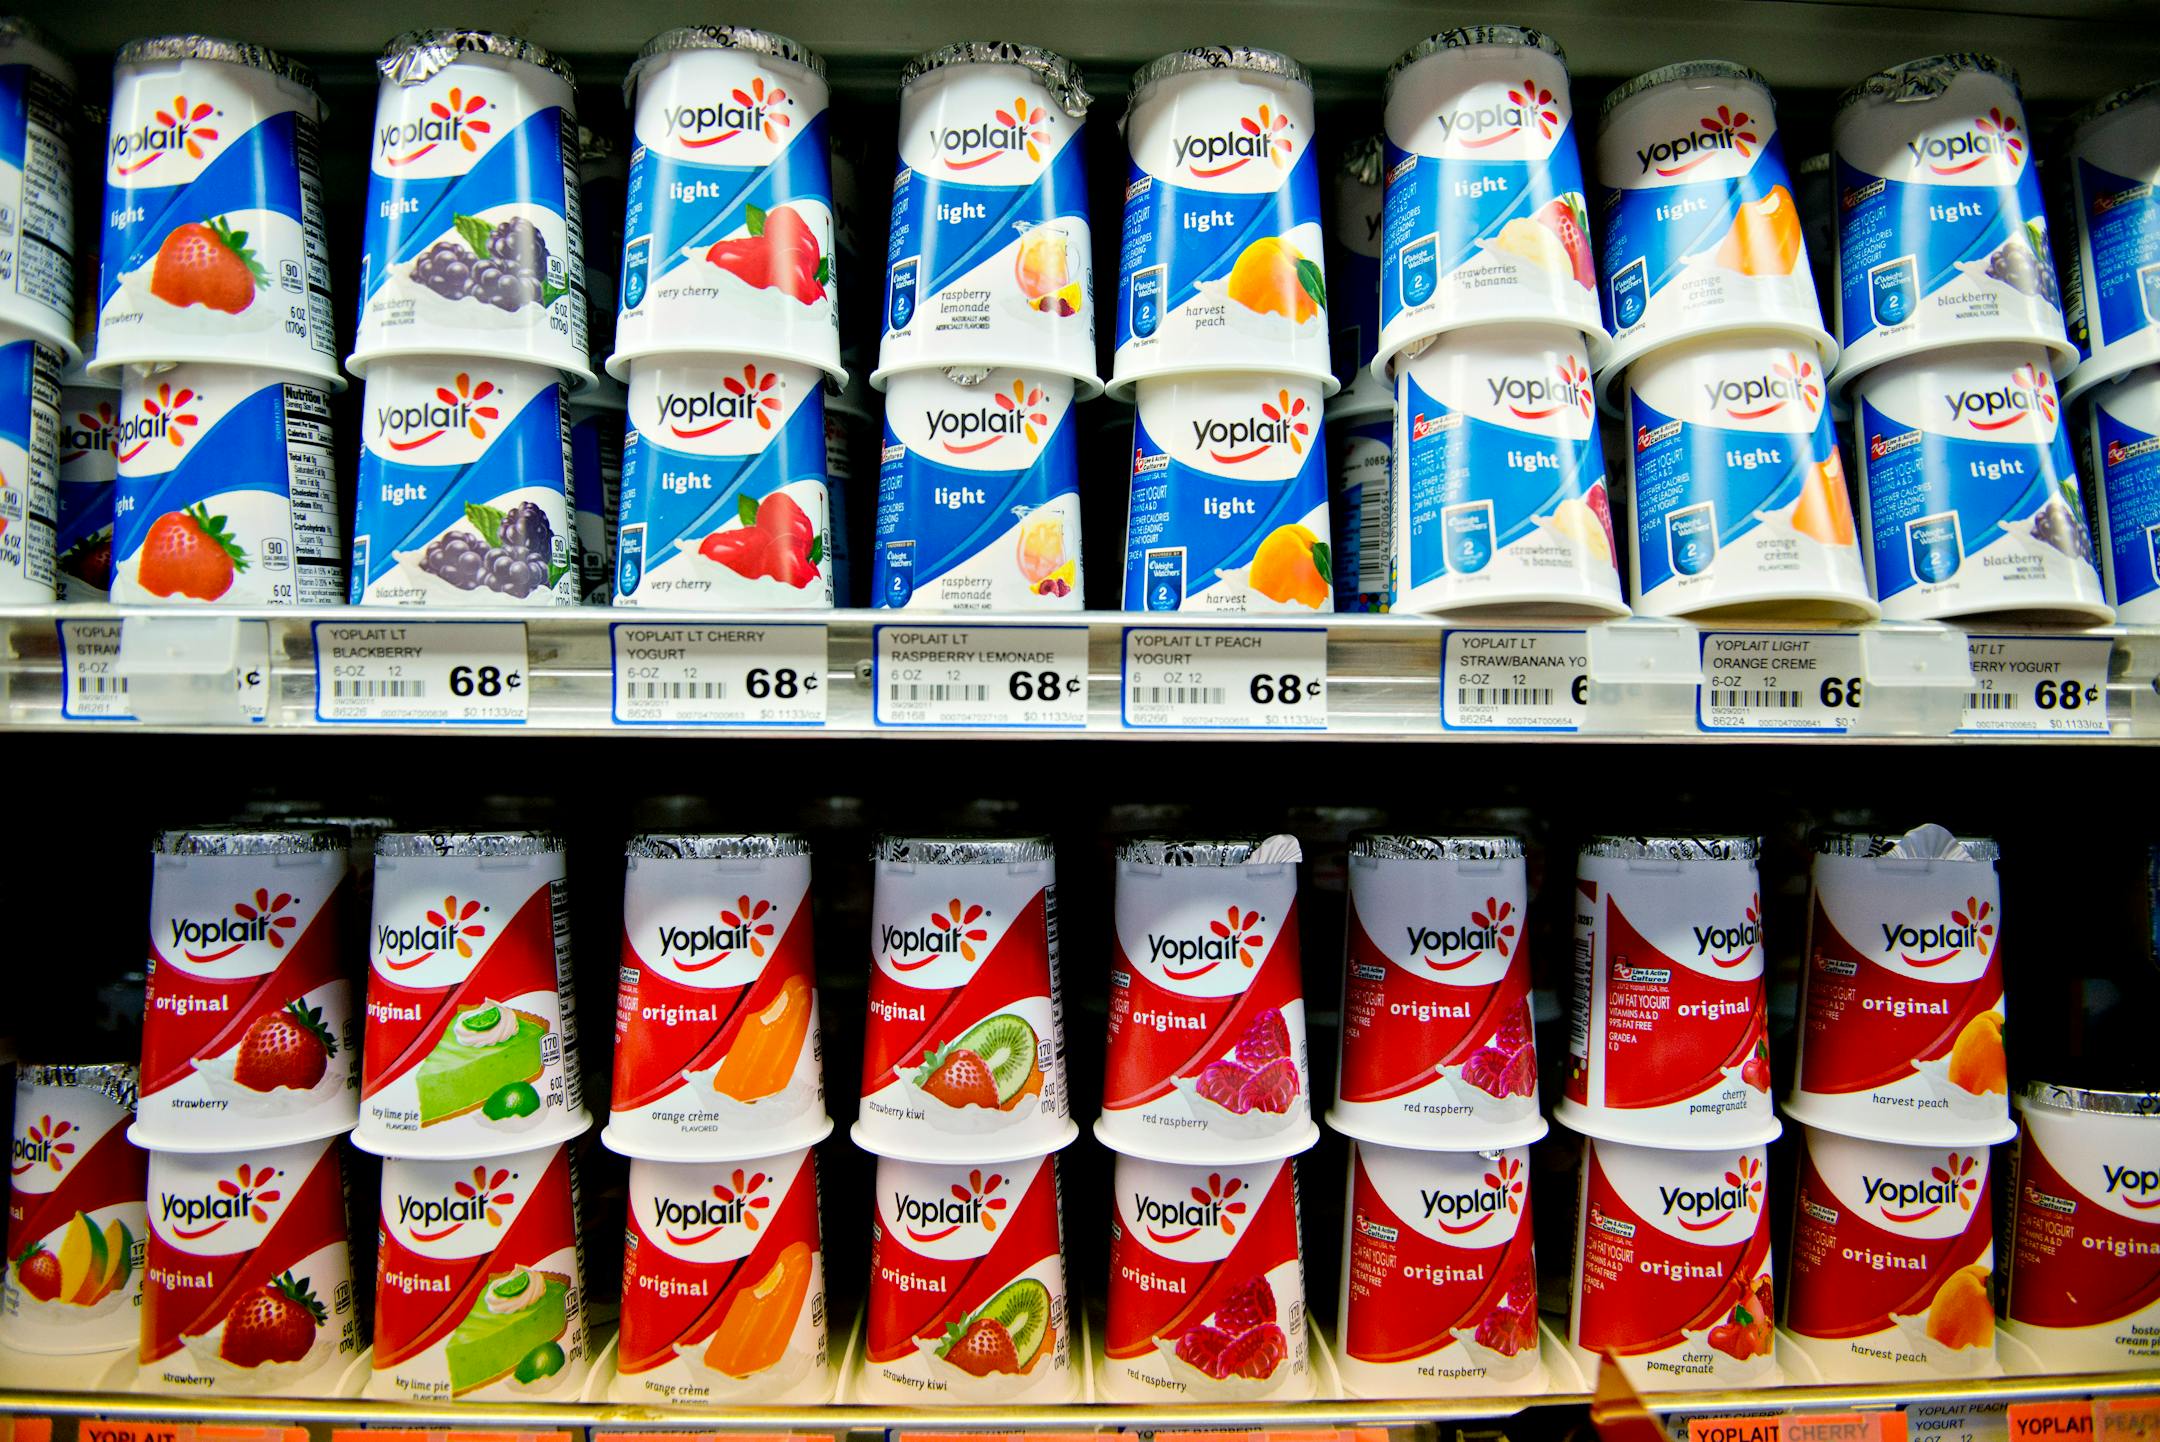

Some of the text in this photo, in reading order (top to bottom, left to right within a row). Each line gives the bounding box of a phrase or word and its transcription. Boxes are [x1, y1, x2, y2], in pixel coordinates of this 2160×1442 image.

[665, 106, 765, 137] Yoplait
[1438, 105, 1538, 140] Yoplait
[380, 116, 462, 156] Yoplait
[930, 123, 1028, 159] Yoplait
[1173, 132, 1271, 167] Yoplait
[1636, 128, 1735, 174] Yoplait
[1908, 132, 2005, 167] Yoplait
[670, 181, 720, 203] light
[1455, 177, 1508, 198] light
[381, 197, 419, 220] light
[937, 202, 986, 224] light
[1656, 198, 1707, 221] light
[1929, 202, 1982, 222] light
[111, 208, 144, 230] light
[1184, 211, 1234, 232] light
[942, 290, 991, 302] raspberry
[1938, 292, 1998, 306] blackberry
[941, 302, 990, 313] lemonade
[1186, 306, 1225, 316] harvest
[1196, 316, 1225, 328] peach
[1488, 376, 1579, 406] Yoplait
[1705, 376, 1802, 410] Yoplait
[657, 391, 756, 425] Yoplait
[1946, 387, 2040, 420] Yoplait
[379, 402, 470, 437] Yoplait
[927, 408, 1025, 440] Yoplait
[1193, 418, 1290, 450] Yoplait
[1508, 452, 1560, 472] light
[1727, 449, 1781, 469] light
[1970, 460, 2024, 479] light
[662, 472, 712, 494] light
[382, 483, 427, 505] light
[935, 487, 985, 508] light
[1204, 497, 1255, 518] light
[1984, 555, 2043, 566] blackberry
[942, 577, 992, 589] raspberry
[942, 589, 992, 600] lemonade
[1207, 593, 1246, 604] harvest
[330, 629, 406, 640] YOPLAIT LT
[626, 631, 765, 642] YOPLAIT LT CHERRY
[891, 634, 968, 644] YOPLAIT LT
[1135, 636, 1261, 648] YOPLAIT LT PEACH
[1462, 638, 1536, 649] YOPLAIT LT
[334, 648, 422, 658] BLACKBERRY
[627, 650, 685, 659] YOGURT
[1716, 640, 1809, 651] YOPLAIT LIGHT
[1990, 645, 2005, 655] LT
[892, 652, 1054, 663] RASPBERRY LEMONADE
[1134, 654, 1192, 664] YOGURT
[1461, 656, 1565, 667] STRAW/BANANA
[1713, 658, 1816, 669] ORANGE CREME
[628, 668, 659, 678] 6-OZ
[2010, 663, 2060, 673] YOGURT
[450, 666, 520, 696] 68¢
[747, 669, 818, 698] 68¢
[1010, 671, 1080, 701] 68¢
[1250, 674, 1320, 704] 68¢
[1459, 675, 1526, 685] 6-OZ 12
[1712, 677, 1776, 687] 6-OZ 12
[2035, 680, 2098, 709] 68¢
[1713, 717, 1744, 725] 86224
[2050, 720, 2103, 729] $0.1133/oz
[172, 916, 269, 948] Yoplait
[378, 924, 458, 955] Yoplait
[659, 926, 751, 957] Yoplait
[882, 924, 961, 956] Yoplait
[1407, 927, 1497, 956] Yoplait
[1882, 924, 1977, 953] Yoplait
[1149, 934, 1239, 965] Yoplait
[157, 994, 228, 1014] original
[1610, 993, 1670, 1009] LOW FAT YOGURT
[1677, 997, 1749, 1020] original
[1862, 997, 1949, 1017] original
[643, 1005, 717, 1025] original
[871, 1001, 925, 1022] original
[1133, 1011, 1206, 1031] original
[1390, 1002, 1470, 1021] original
[172, 1099, 228, 1110] strawberry
[1722, 1090, 1747, 1100] cherry
[1873, 1094, 1949, 1108] harvest peach
[385, 1107, 419, 1123] lime pie
[652, 1110, 719, 1122] orange crème
[869, 1100, 924, 1120] strawberry kiwi
[1404, 1102, 1474, 1116] red raspberry
[1690, 1101, 1747, 1114] pomegranate
[1142, 1113, 1208, 1130] red raspberry
[1421, 1185, 1509, 1219] Yoplait
[1660, 1184, 1748, 1217] Yoplait
[1863, 1176, 1958, 1208] Yoplait
[162, 1192, 251, 1224] Yoplait
[399, 1194, 488, 1227] Yoplait
[654, 1197, 745, 1231] Yoplait
[895, 1192, 982, 1228] Yoplait
[1135, 1193, 1221, 1228] Yoplait
[1843, 1248, 1926, 1269] original
[150, 1268, 213, 1289] original
[882, 1268, 946, 1292] original
[1122, 1266, 1186, 1293] original
[1404, 1265, 1484, 1284] original
[1641, 1260, 1722, 1281] original
[386, 1272, 450, 1293] original
[640, 1275, 708, 1297] original
[1683, 1352, 1713, 1363] cherry
[1852, 1343, 1927, 1363] harvest peach
[1418, 1366, 1487, 1379] red raspberry
[1647, 1361, 1713, 1374] pomegranate
[164, 1373, 214, 1386] strawberry
[396, 1376, 449, 1393] key lime pie
[646, 1381, 709, 1395] orange crème
[883, 1368, 946, 1390] strawberry kiwi
[1128, 1368, 1186, 1392] red raspberry
[1918, 1403, 2007, 1416] YOPLAIT PEACH
[1698, 1426, 1779, 1442] YOPLAIT
[1789, 1424, 1869, 1441] CHERRY
[1916, 1419, 1965, 1430] YOGURT
[2018, 1417, 2093, 1435] YOPLAIT
